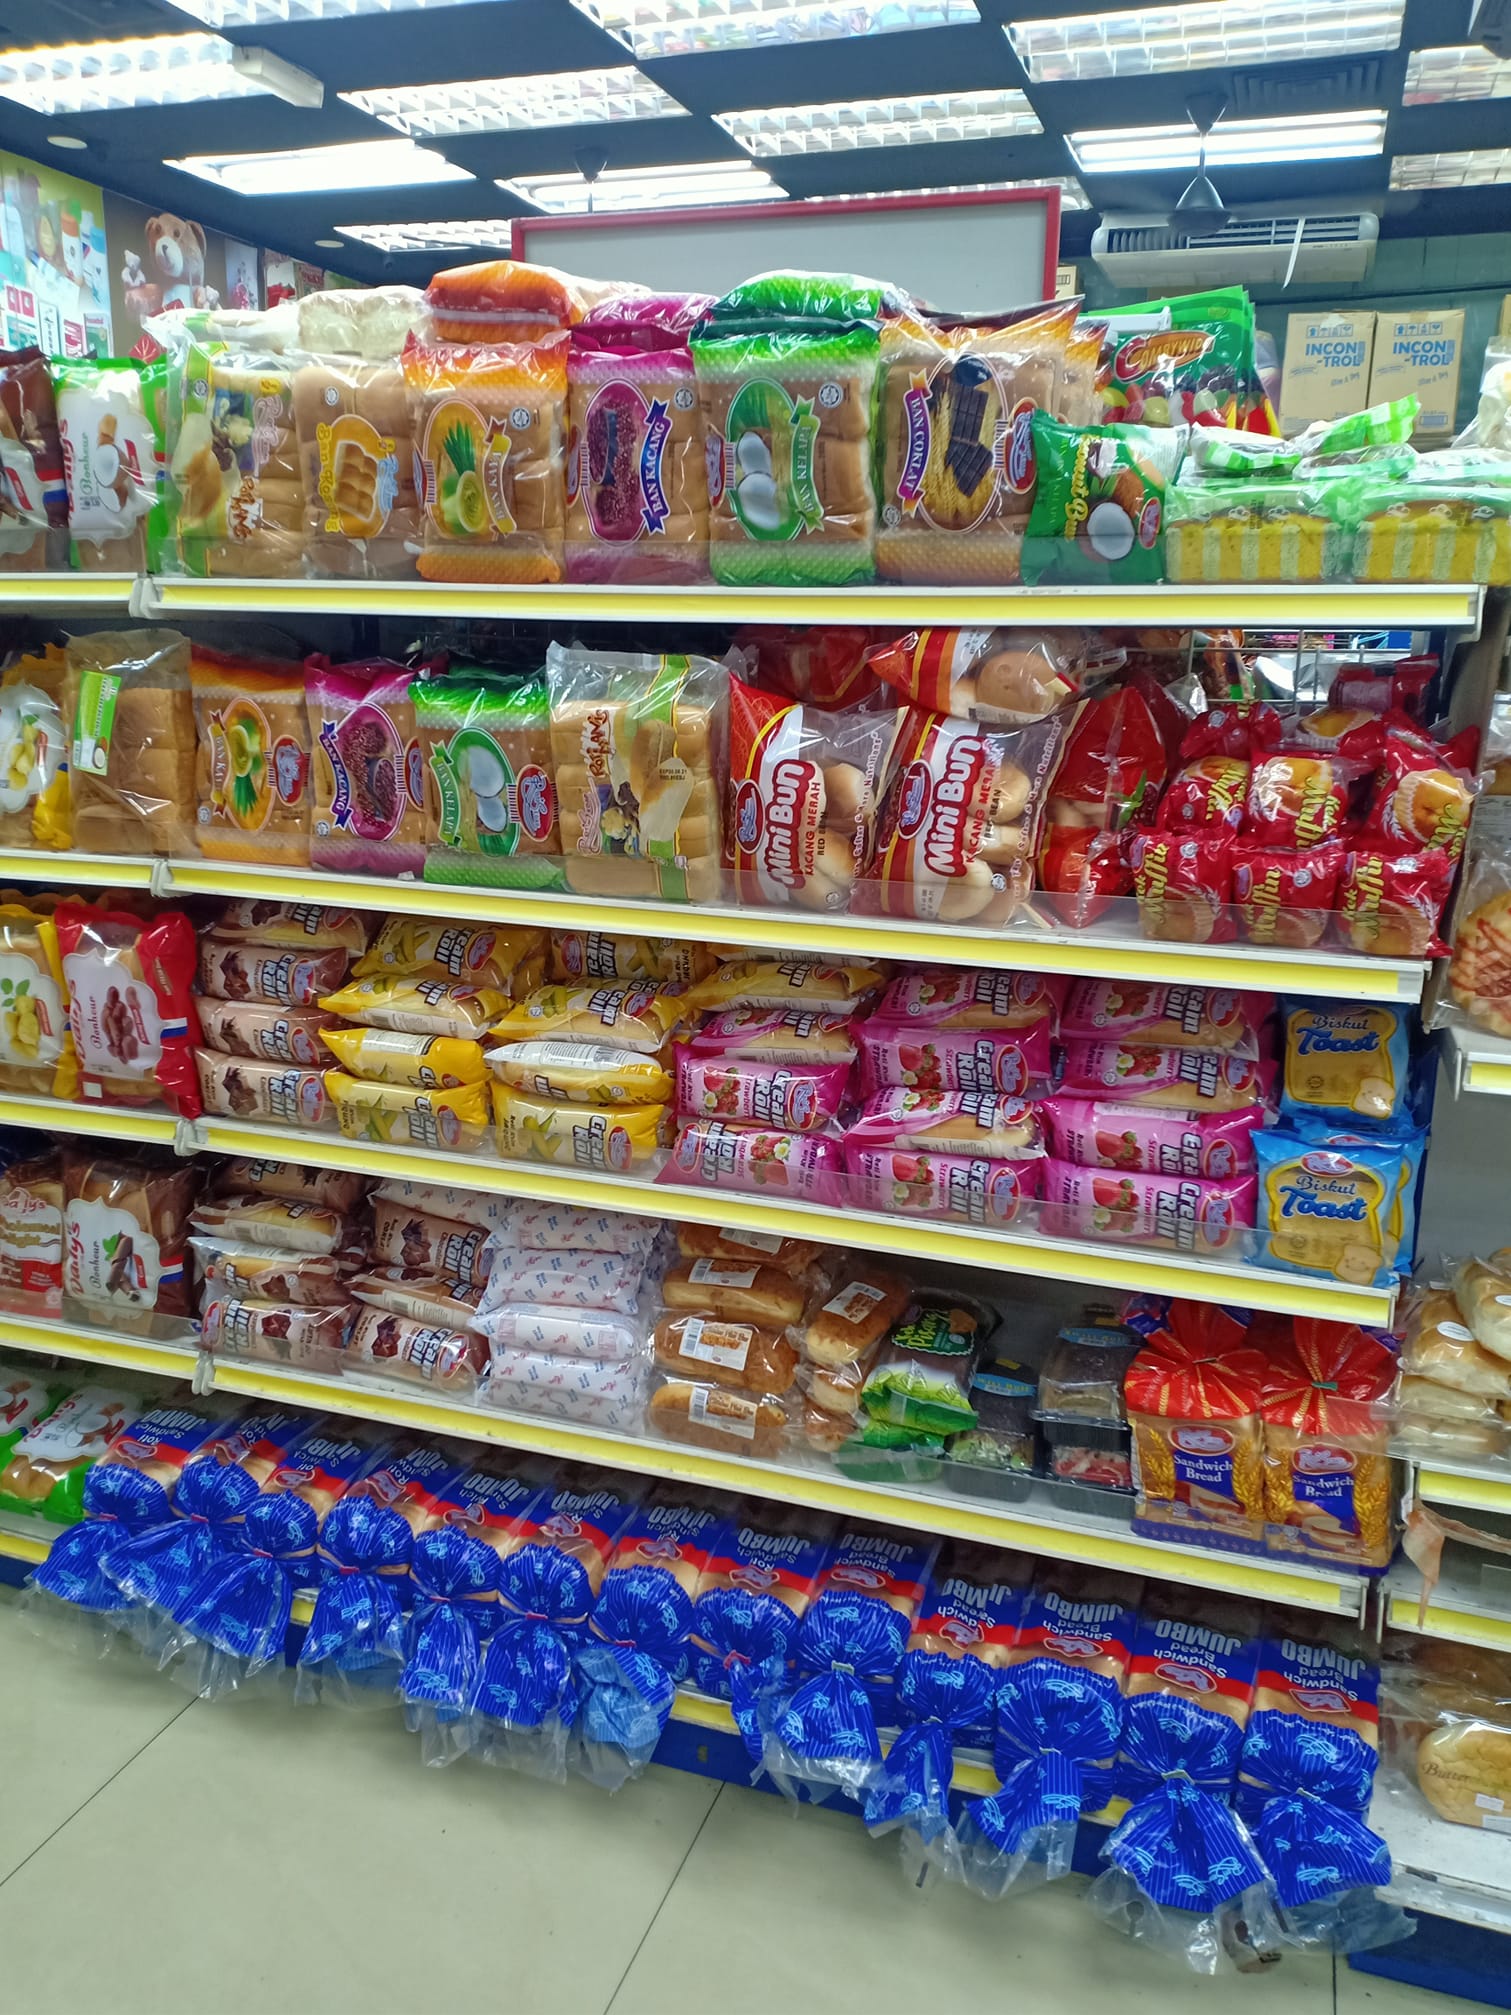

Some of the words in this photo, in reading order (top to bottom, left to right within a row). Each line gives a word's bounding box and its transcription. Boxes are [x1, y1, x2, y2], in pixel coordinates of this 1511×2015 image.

[1305, 342, 1358, 356] INCON
[1317, 355, 1361, 367] -TROL
[1393, 341, 1446, 354] INCON
[1404, 354, 1450, 366] -TROL
[911, 398, 923, 425] BAN
[79, 432, 90, 495] Bonheur
[645, 421, 665, 478] KACANG
[796, 426, 812, 480] KELAPA
[904, 431, 925, 490] COKLAT
[489, 490, 505, 520] BAN
[646, 478, 664, 513] BAN
[799, 483, 815, 513] BAN
[1063, 498, 1089, 540] Bun
[322, 738, 338, 762] BAN
[332, 761, 350, 812] KACANG
[588, 746, 607, 778] ROTI
[938, 736, 983, 803] Bun
[437, 761, 450, 788] BAN
[444, 788, 458, 836] KELAPA
[770, 761, 804, 825] Bun
[810, 782, 821, 826] MERAH
[989, 789, 1002, 816] BEAN
[768, 826, 797, 886] Mini
[805, 830, 816, 876] KACANG
[927, 805, 960, 874] Mini
[1143, 842, 1169, 925] Muffin
[1355, 855, 1385, 941] Muffin
[1251, 866, 1282, 945] Muffin
[1341, 887, 1359, 923] Kek
[448, 926, 475, 977] ream
[586, 930, 601, 978] ream
[274, 952, 297, 1009] Cream
[91, 995, 103, 1049] Bonheur
[1296, 1027, 1380, 1056] Toast
[1312, 1014, 1369, 1030] Biskut
[283, 1068, 301, 1125] Cream
[769, 1069, 793, 1130] Cream
[968, 1158, 991, 1223] Cream
[1279, 1185, 1369, 1222] Toast
[1296, 1175, 1356, 1195] Biskut
[1175, 1180, 1201, 1250] Cream
[88, 1240, 101, 1289] Bonheur
[456, 1229, 484, 1289] Cream
[1174, 1454, 1234, 1472] Sandwich
[1186, 1467, 1223, 1483] Bread
[1293, 1474, 1355, 1488] Sandwich
[737, 1527, 811, 1556] JUMBO
[849, 1551, 889, 1565] Bread
[1043, 1591, 1124, 1623] JUMBO
[1058, 1618, 1101, 1634] Bread
[1043, 1619, 1113, 1642] Sandwich
[1154, 1618, 1242, 1657] JUMBO
[1153, 1648, 1228, 1679] Sandwich
[1170, 1641, 1216, 1663] Bread
[1280, 1637, 1367, 1682] JUMBO
[1283, 1669, 1358, 1702] Sandwich
[1299, 1665, 1344, 1686] Bread
